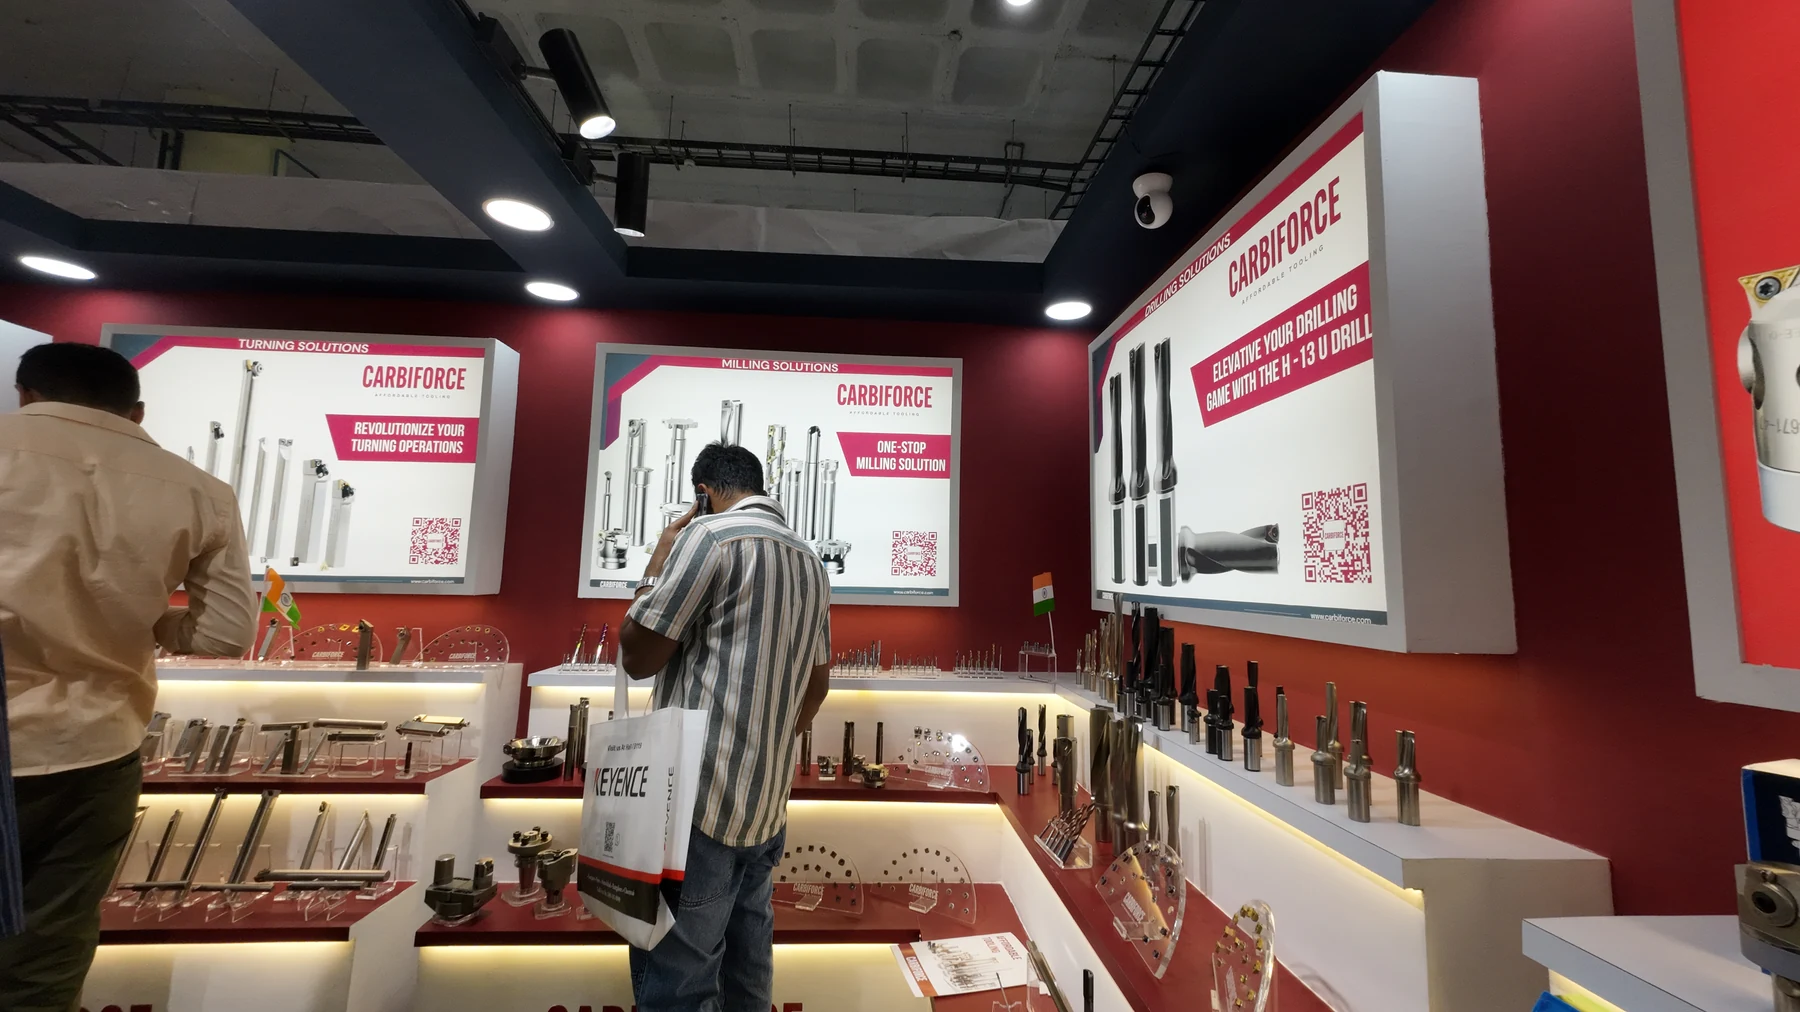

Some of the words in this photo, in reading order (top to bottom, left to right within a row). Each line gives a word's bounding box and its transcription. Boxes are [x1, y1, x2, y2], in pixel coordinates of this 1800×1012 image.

[1228, 175, 1342, 298] CARBIFORCE
[1144, 280, 1178, 317] DRILLING
[1178, 232, 1231, 288] SOLUTIONS
[1241, 271, 1286, 305] AFFORDABLE
[1288, 244, 1325, 273] TOOLING
[1212, 337, 1263, 384] ELEVATIVE
[1263, 320, 1294, 355] YOUR
[1296, 283, 1358, 339] DRILLING
[238, 338, 295, 351] TURNING
[297, 341, 369, 354] SOLUTIONS
[721, 358, 770, 371] MILLING
[772, 360, 839, 373] SOLUTIONS
[1206, 382, 1231, 412] GAME
[1231, 369, 1257, 401] WITH
[1258, 358, 1280, 388] THE
[1317, 334, 1328, 361] U
[1330, 313, 1373, 356] DRILL
[362, 365, 467, 391] CARBIFORCE
[836, 383, 933, 409] CARBIFORCE
[353, 421, 435, 437] REVOLUTIONIZE
[436, 423, 466, 437] YOUR
[351, 438, 397, 453] TURNING
[398, 439, 464, 454] OPERATIONS
[876, 440, 927, 455] ONE-STOP
[856, 456, 897, 471] MILLING
[898, 457, 946, 472] SOLUTION
[1310, 612, 1372, 625] www.carbiforce.com
[593, 765, 649, 797] KEYENCE
[793, 882, 825, 894] CARBIFORCE
[908, 883, 939, 900] CARBIFORCE
